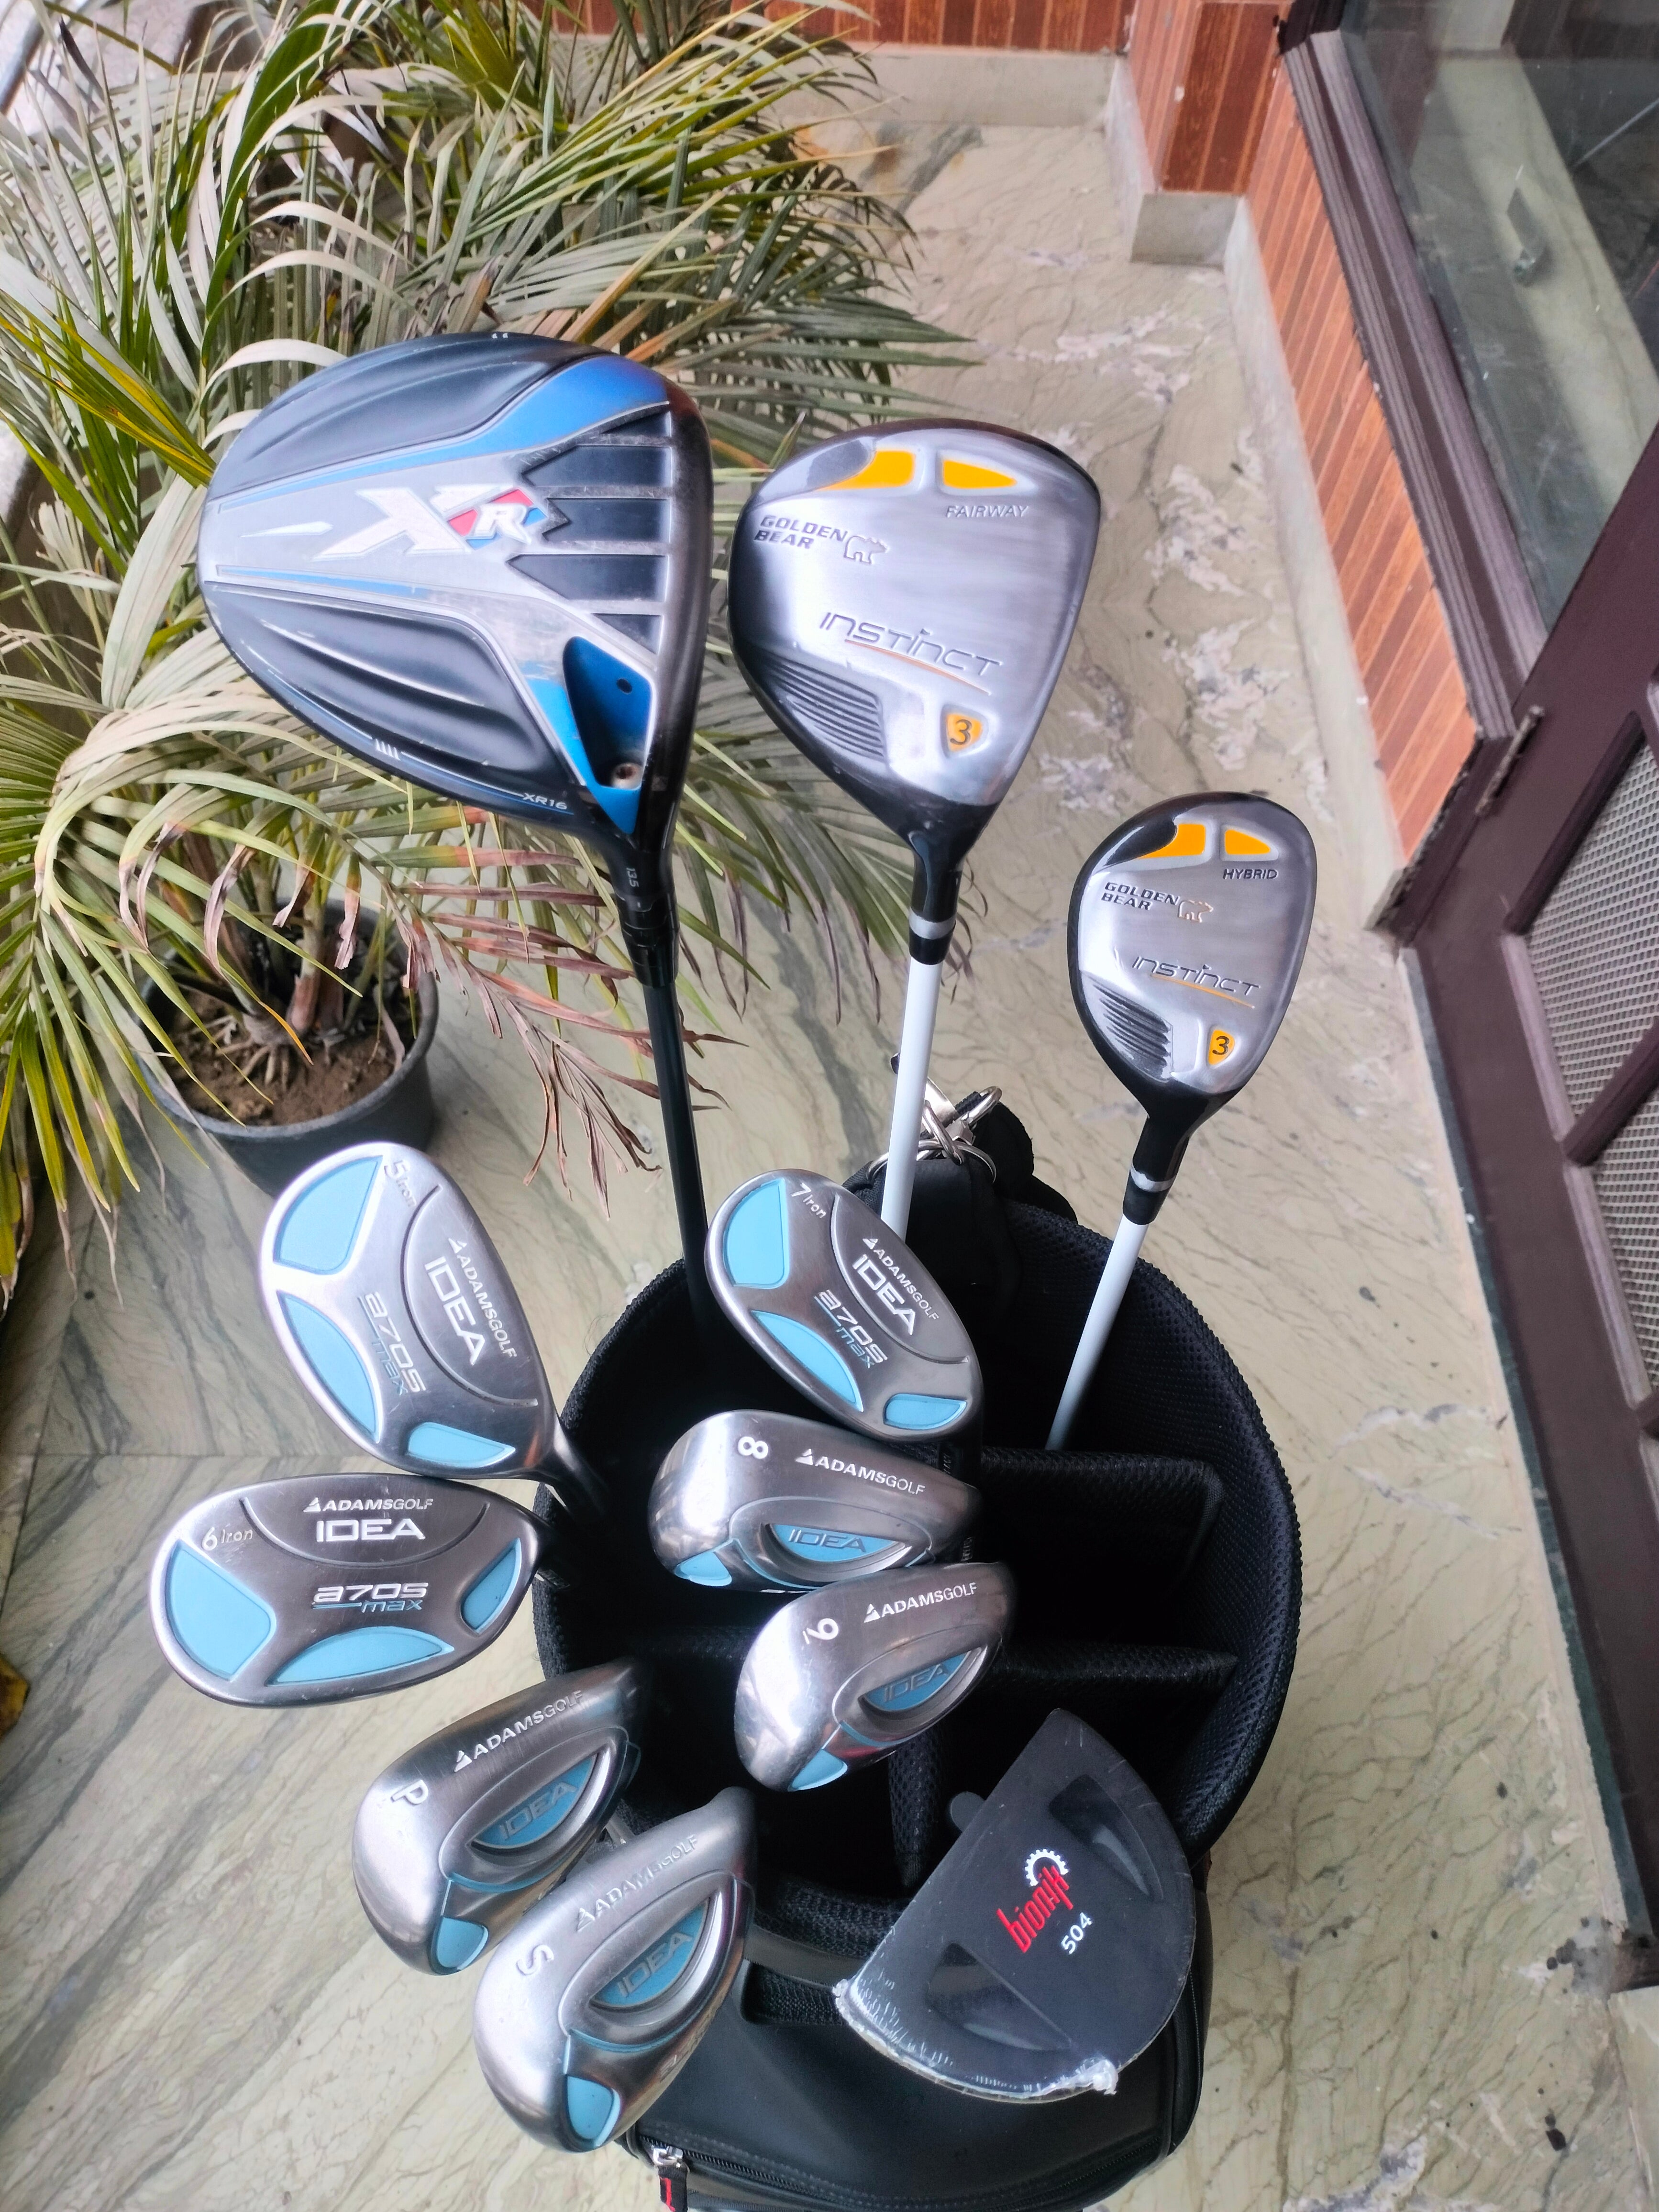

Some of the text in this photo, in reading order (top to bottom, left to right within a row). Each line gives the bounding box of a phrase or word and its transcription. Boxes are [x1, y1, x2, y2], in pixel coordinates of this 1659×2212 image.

[945, 505, 1029, 518] FAIRWAY
[753, 530, 815, 549] BEAR
[760, 515, 850, 542] GOLDEN
[950, 719, 973, 746] 3
[523, 793, 567, 810] XR16
[1223, 869, 1278, 880] HYBRID
[1101, 892, 1153, 910] BEAR
[1105, 882, 1180, 906] GOLDEN
[1212, 1035, 1230, 1055] 3
[852, 1254, 916, 1335] IDEA
[874, 1248, 939, 1321] ADAMSGOLF
[424, 1256, 488, 1365] IDEA
[456, 1254, 517, 1358] ADAMSGOLF
[737, 1436, 769, 1459] 8
[815, 1455, 926, 1496] ADAMSGOLF
[323, 1498, 433, 1512] ADAMSGOLF
[201, 1526, 218, 1551] 6
[316, 1518, 425, 1542] IDEA
[788, 1529, 866, 1553] IDEA
[881, 1582, 977, 1617] ADAMSGOLF
[884, 1663, 948, 1703] IDEA
[473, 1690, 583, 1759] ADAMSGOLF
[391, 1780, 429, 1805] P
[500, 1783, 578, 1841] IDEA
[1061, 1912, 1093, 1955] 504
[516, 1944, 554, 1976] S
[619, 1932, 692, 1997] IDEA
